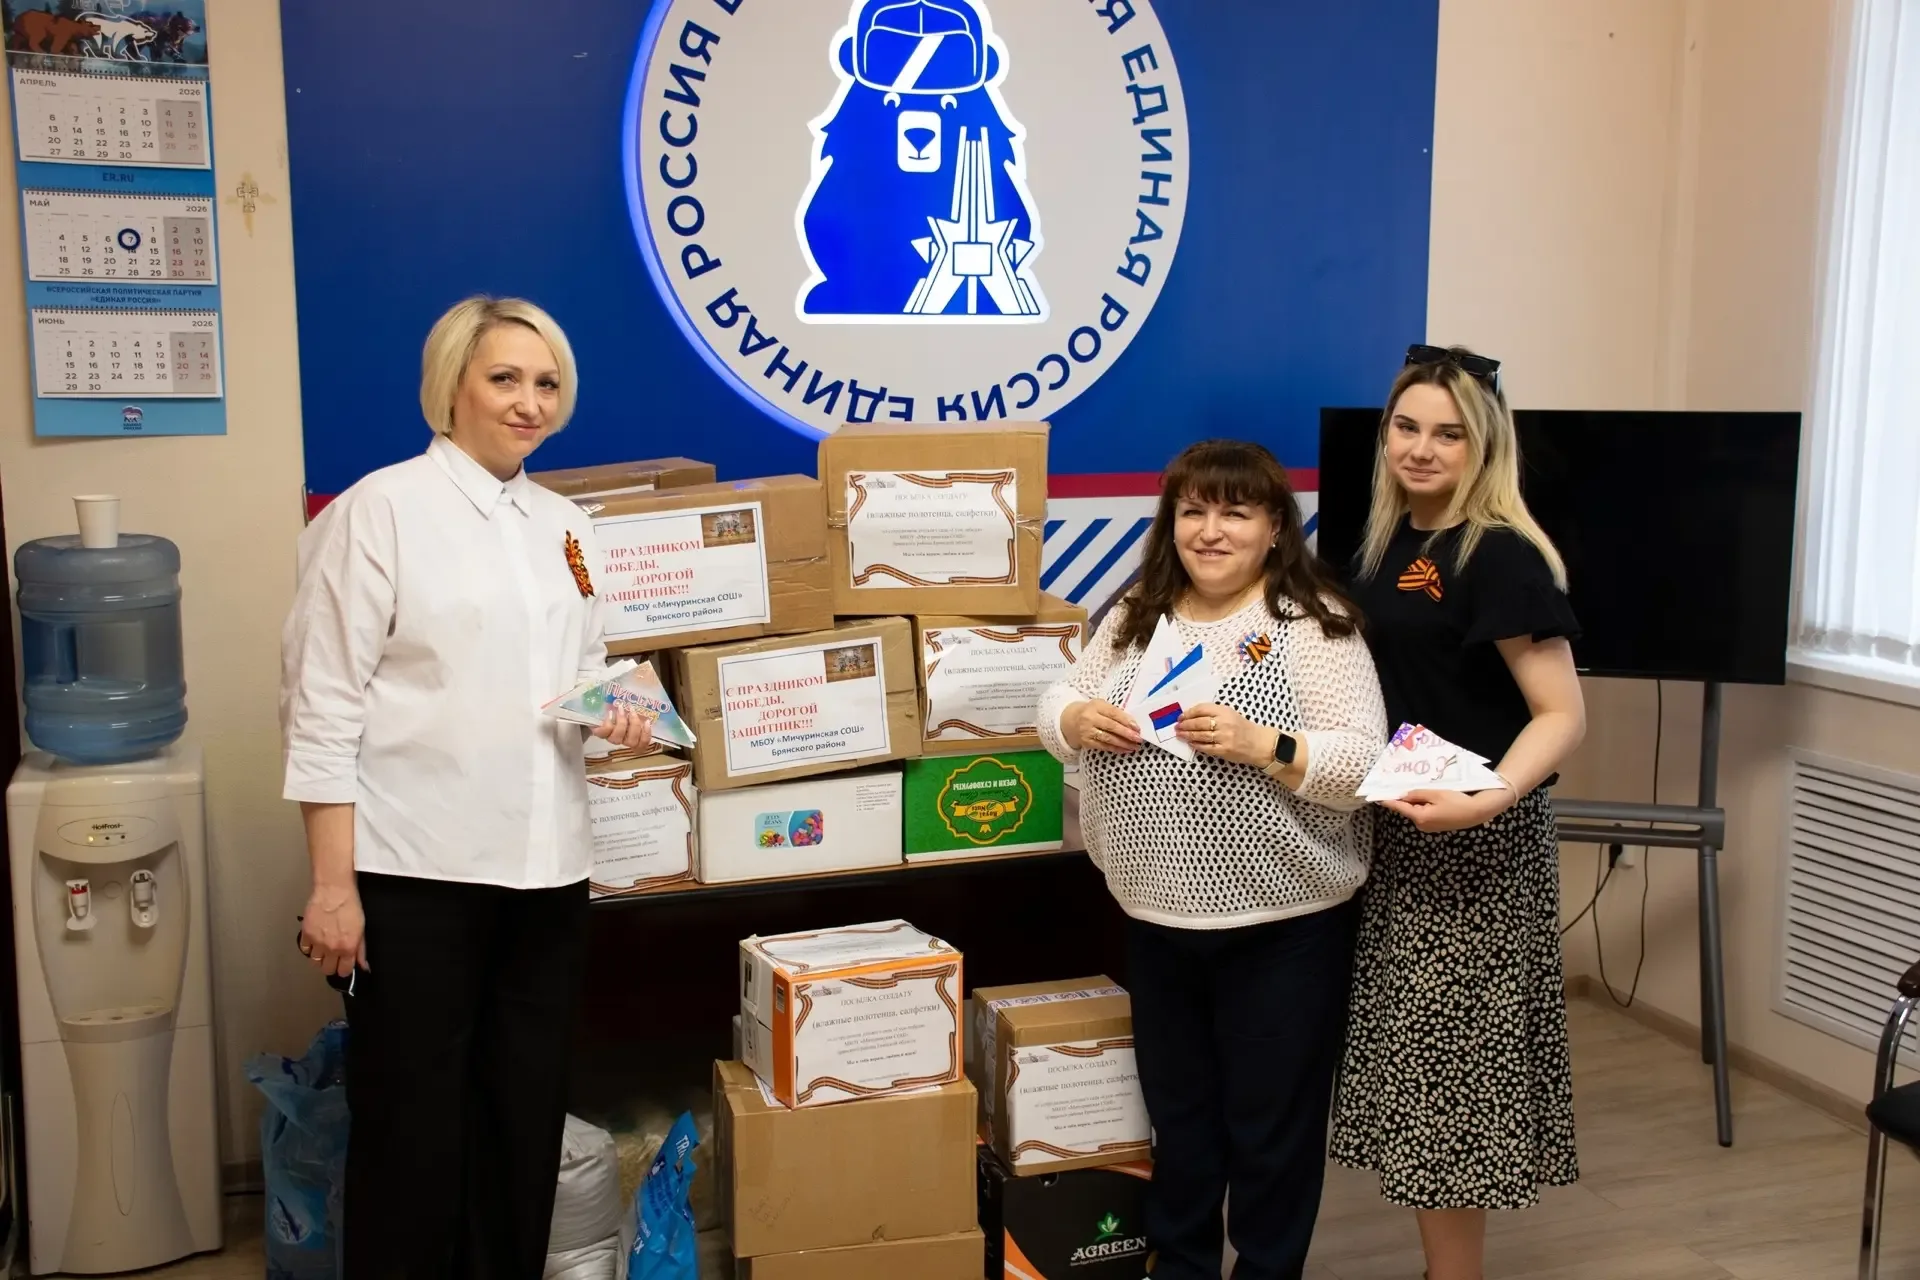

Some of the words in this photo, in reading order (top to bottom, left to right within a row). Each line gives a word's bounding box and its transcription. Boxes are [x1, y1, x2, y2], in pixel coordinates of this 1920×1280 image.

[19, 78, 57, 88] АПРЕЛЬ
[179, 88, 201, 96] 2026
[48, 125, 59, 133] 13
[48, 136, 61, 144] 20
[96, 139, 107, 147] 22
[119, 140, 131, 148] 23
[659, 20, 721, 279] РОССИЯ
[73, 149, 85, 157] 28
[97, 150, 108, 158] 29
[119, 151, 132, 159] 30
[1117, 44, 1173, 286] ЕДИНАЯ
[102, 173, 135, 183] ER.RU
[29, 199, 50, 207] МАЙ
[193, 237, 203, 245] 10
[104, 246, 114, 254] 13
[38, 317, 65, 325] ИЮНЬ
[705, 287, 914, 422] ЕДИНАЯ
[937, 293, 1129, 422] РОССИЯ
[908, 510, 953, 519] полотенца,
[956, 508, 997, 519] салфетки)
[611, 540, 701, 559] ПРАЗДНИКОМ
[632, 568, 694, 587] ДОРОГОЙ
[624, 601, 650, 613] МБОУ
[652, 596, 716, 610] «Мичуринская
[717, 592, 743, 601] СОШ»
[646, 610, 690, 623] Брянского
[692, 607, 723, 618] района
[726, 687, 735, 697] С
[737, 676, 824, 695] ПРАЗДНИКОМ
[606, 681, 670, 714] ПИСЬМО
[727, 695, 784, 711] ПОБЕДЫ,
[758, 702, 818, 722] ДОРОГОЙ
[729, 718, 813, 740] ЗАЩИТНИК!!!
[750, 737, 775, 748] МБОУ
[777, 729, 839, 744] «Мичуринская
[840, 725, 865, 735] СОШ»
[771, 744, 814, 756] Брянского
[815, 740, 846, 751] района
[953, 780, 991, 791] СУХОФРУКТЫ
[993, 780, 997, 788] И
[998, 779, 1017, 787] ОРЕХИ
[642, 804, 678, 816] салфетки)
[812, 1016, 852, 1030] (влажные
[853, 1010, 898, 1023] полотенца,
[899, 1003, 940, 1018] салфетки)
[1084, 1059, 1118, 1070] СОЛДАТУ
[1019, 1081, 1060, 1096] (влажные
[1060, 1077, 1105, 1091] полотенца,
[1070, 1236, 1147, 1261] AGREEN
